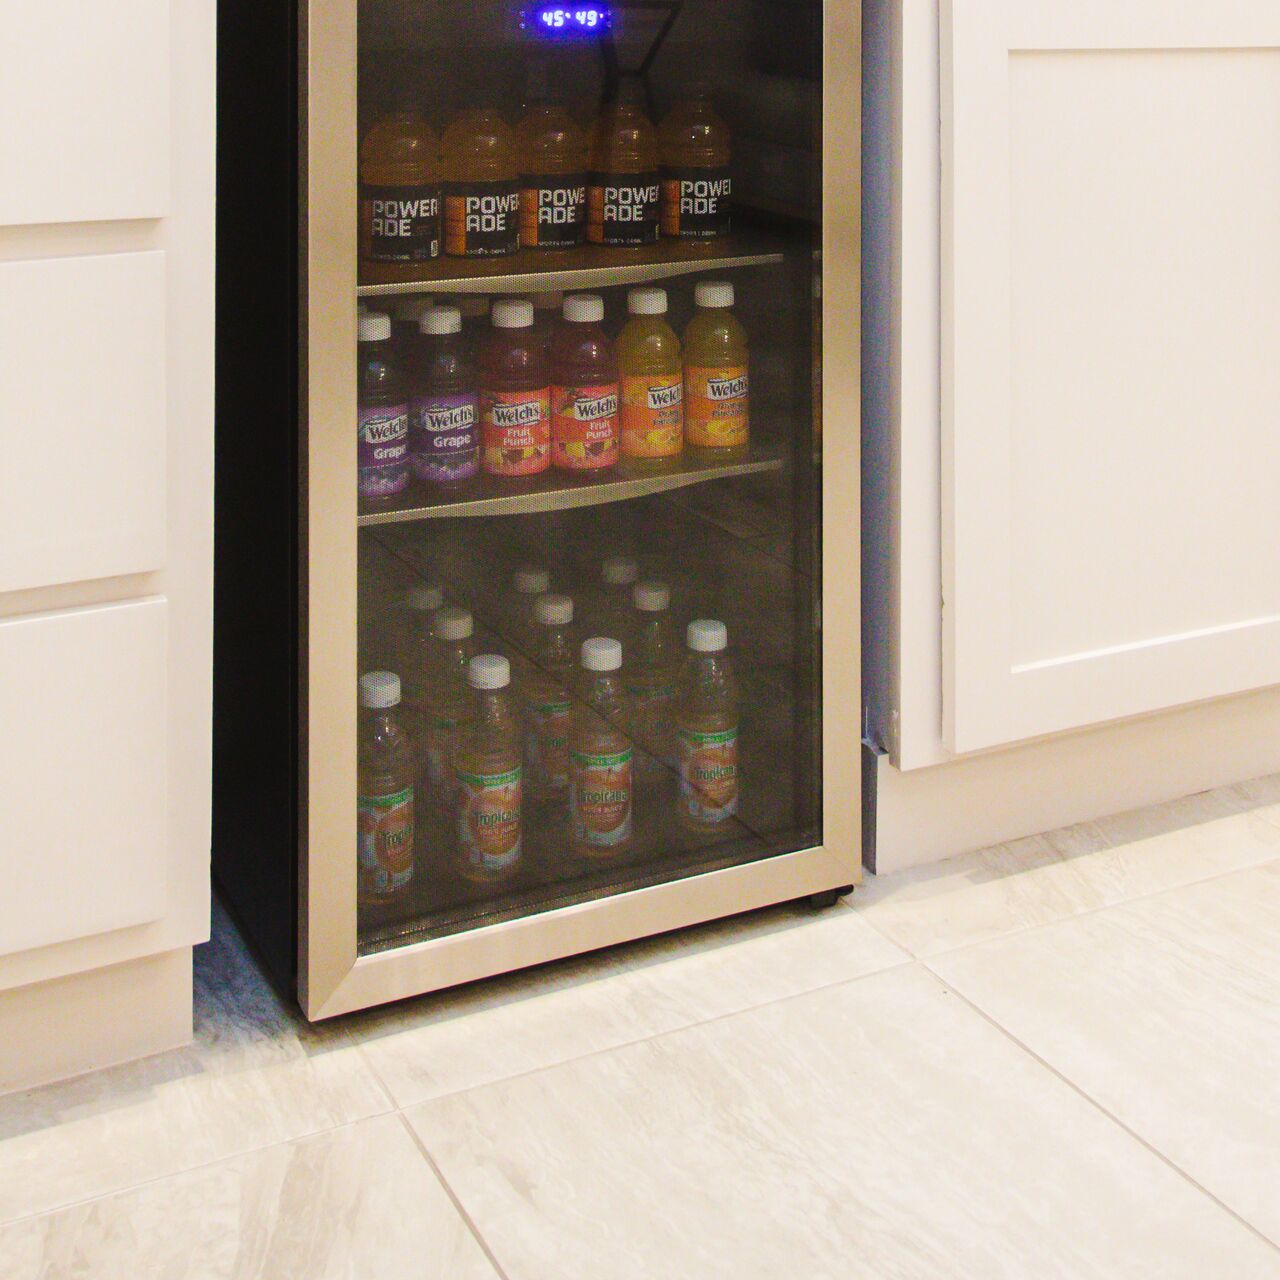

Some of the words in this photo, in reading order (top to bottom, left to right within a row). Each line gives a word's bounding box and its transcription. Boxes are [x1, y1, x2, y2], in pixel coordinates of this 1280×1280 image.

[538, 205, 576, 225] ADE
[603, 204, 644, 223] ADE
[680, 197, 718, 215] ADE
[370, 218, 412, 237] ADE
[466, 213, 507, 233] ADE
[494, 405, 539, 423] Welch's
[577, 395, 616, 417] Welch's
[433, 434, 472, 448] Grape
